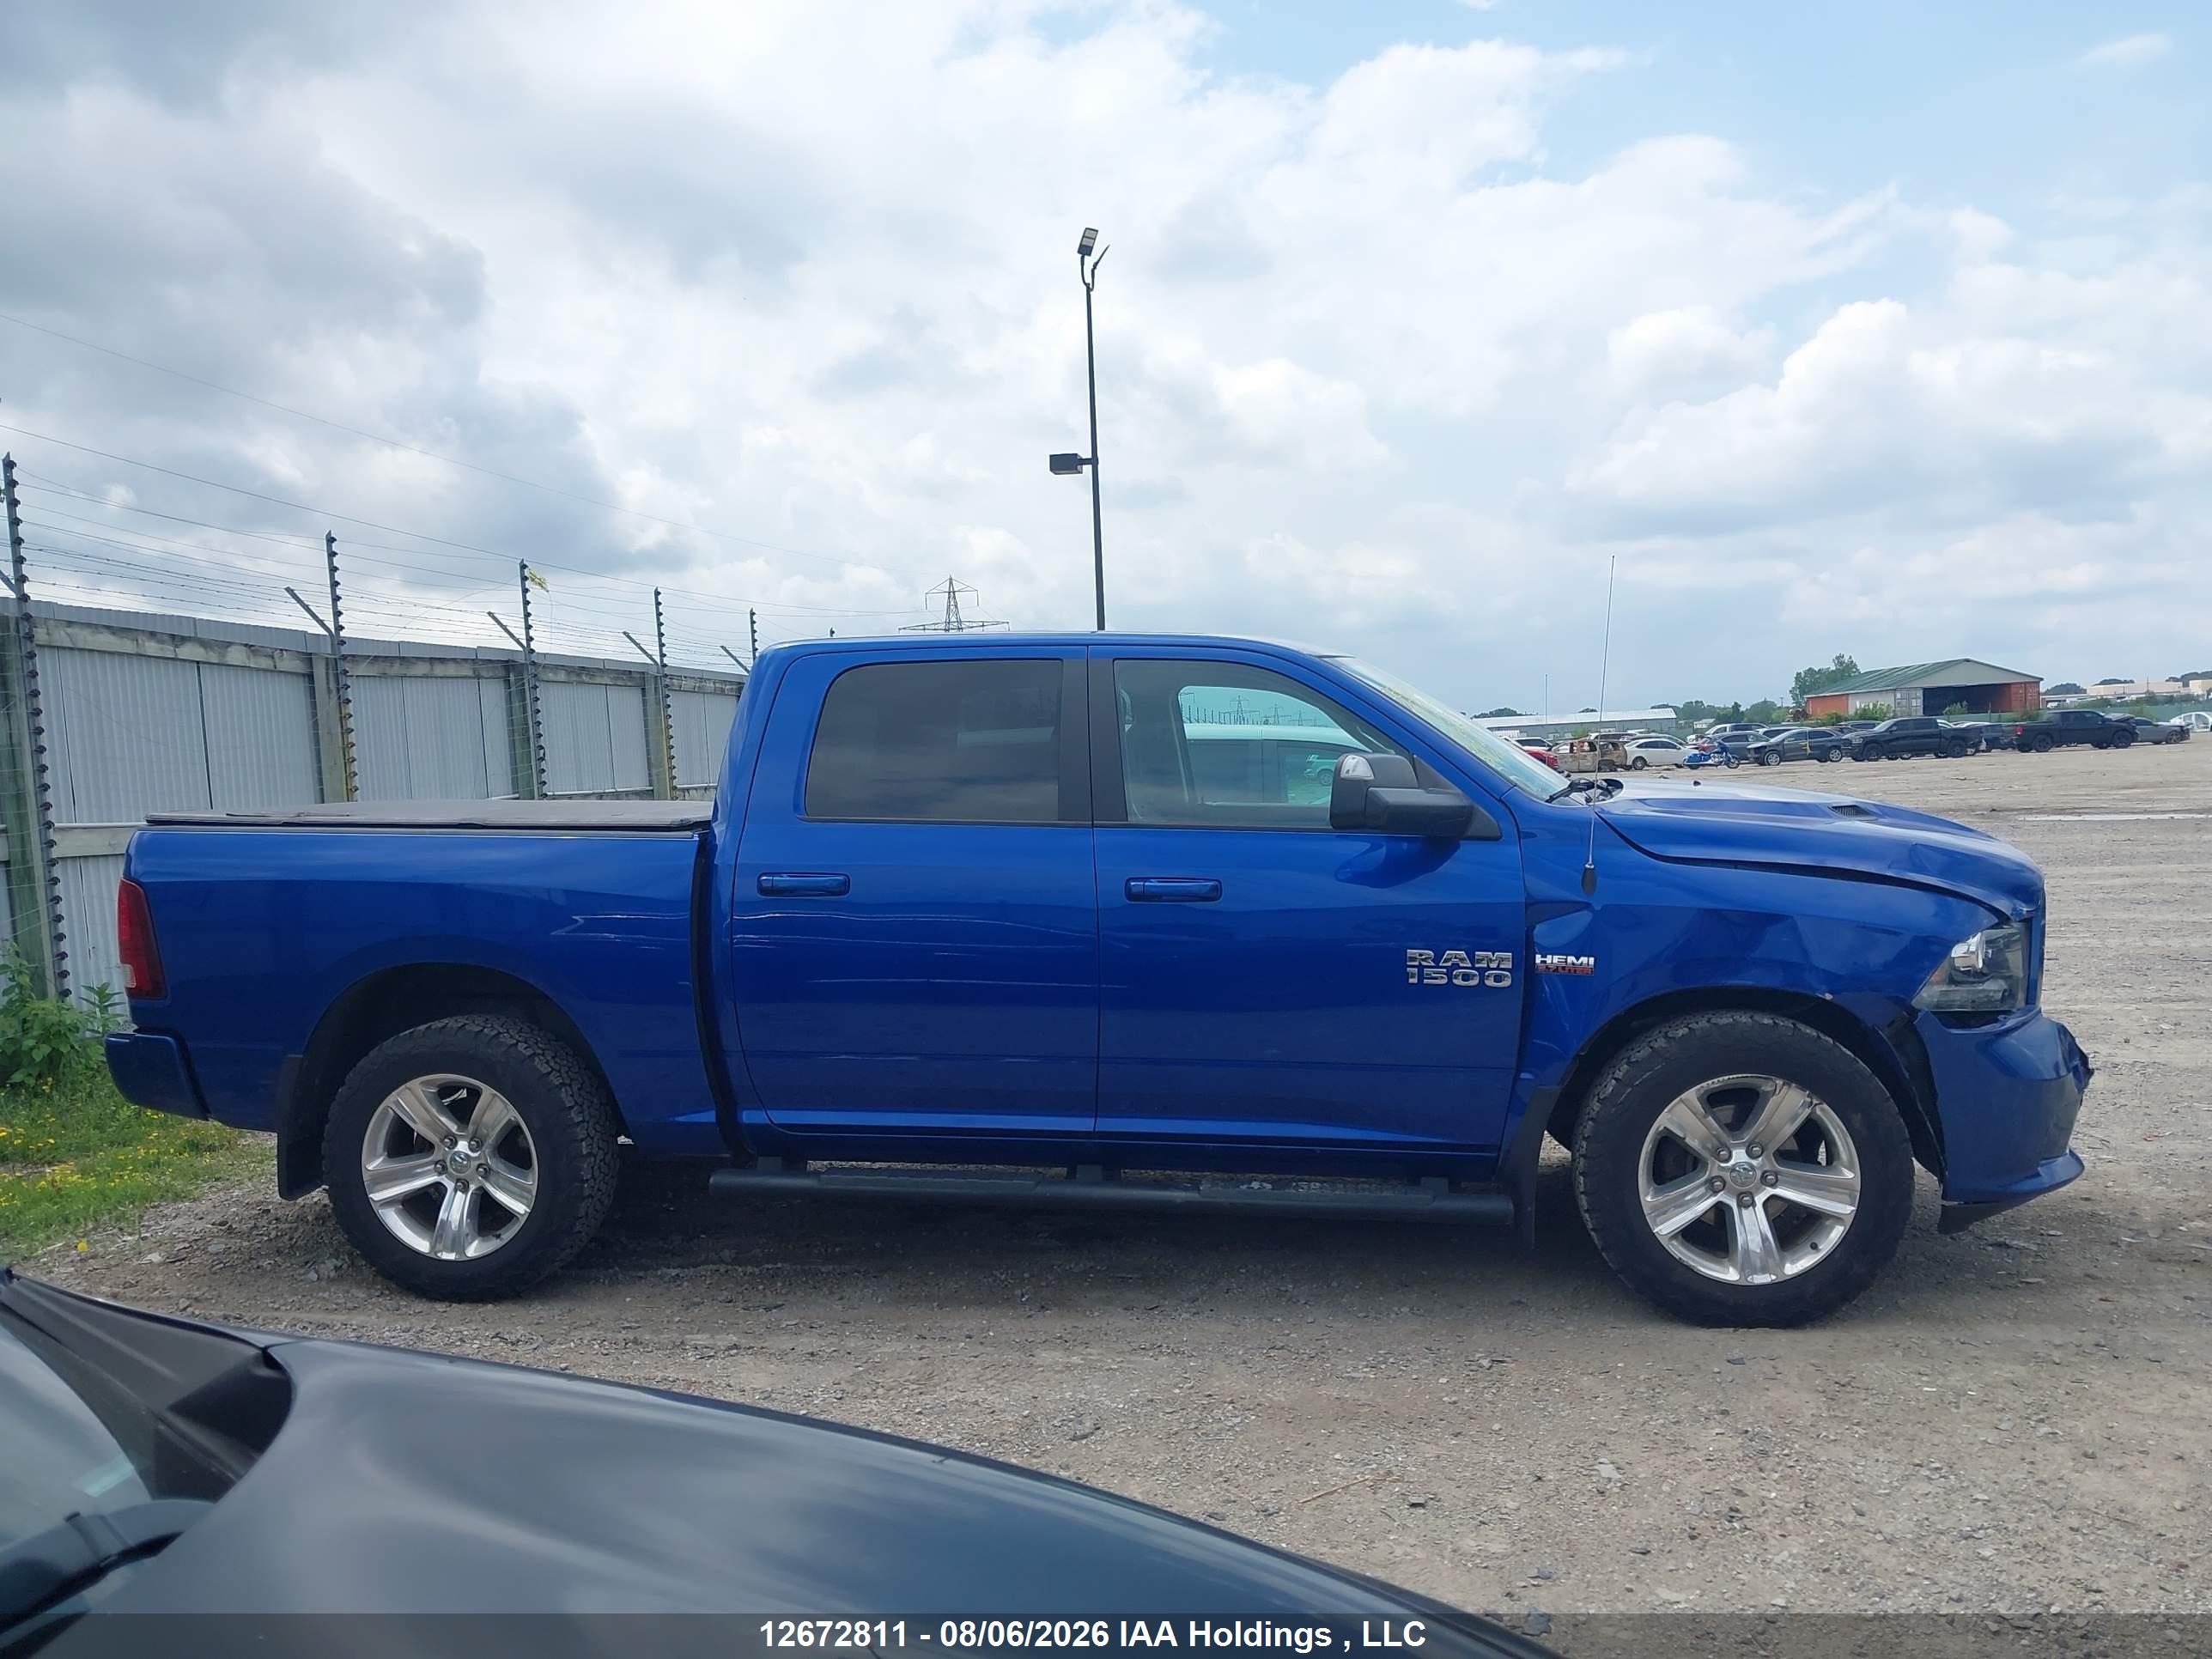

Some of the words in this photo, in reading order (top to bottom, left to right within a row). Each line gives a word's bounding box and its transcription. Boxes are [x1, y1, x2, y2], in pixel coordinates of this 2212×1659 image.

[1406, 949, 1513, 969] RAM
[1534, 954, 1595, 967] HEMI
[1406, 967, 1513, 988] 1500
